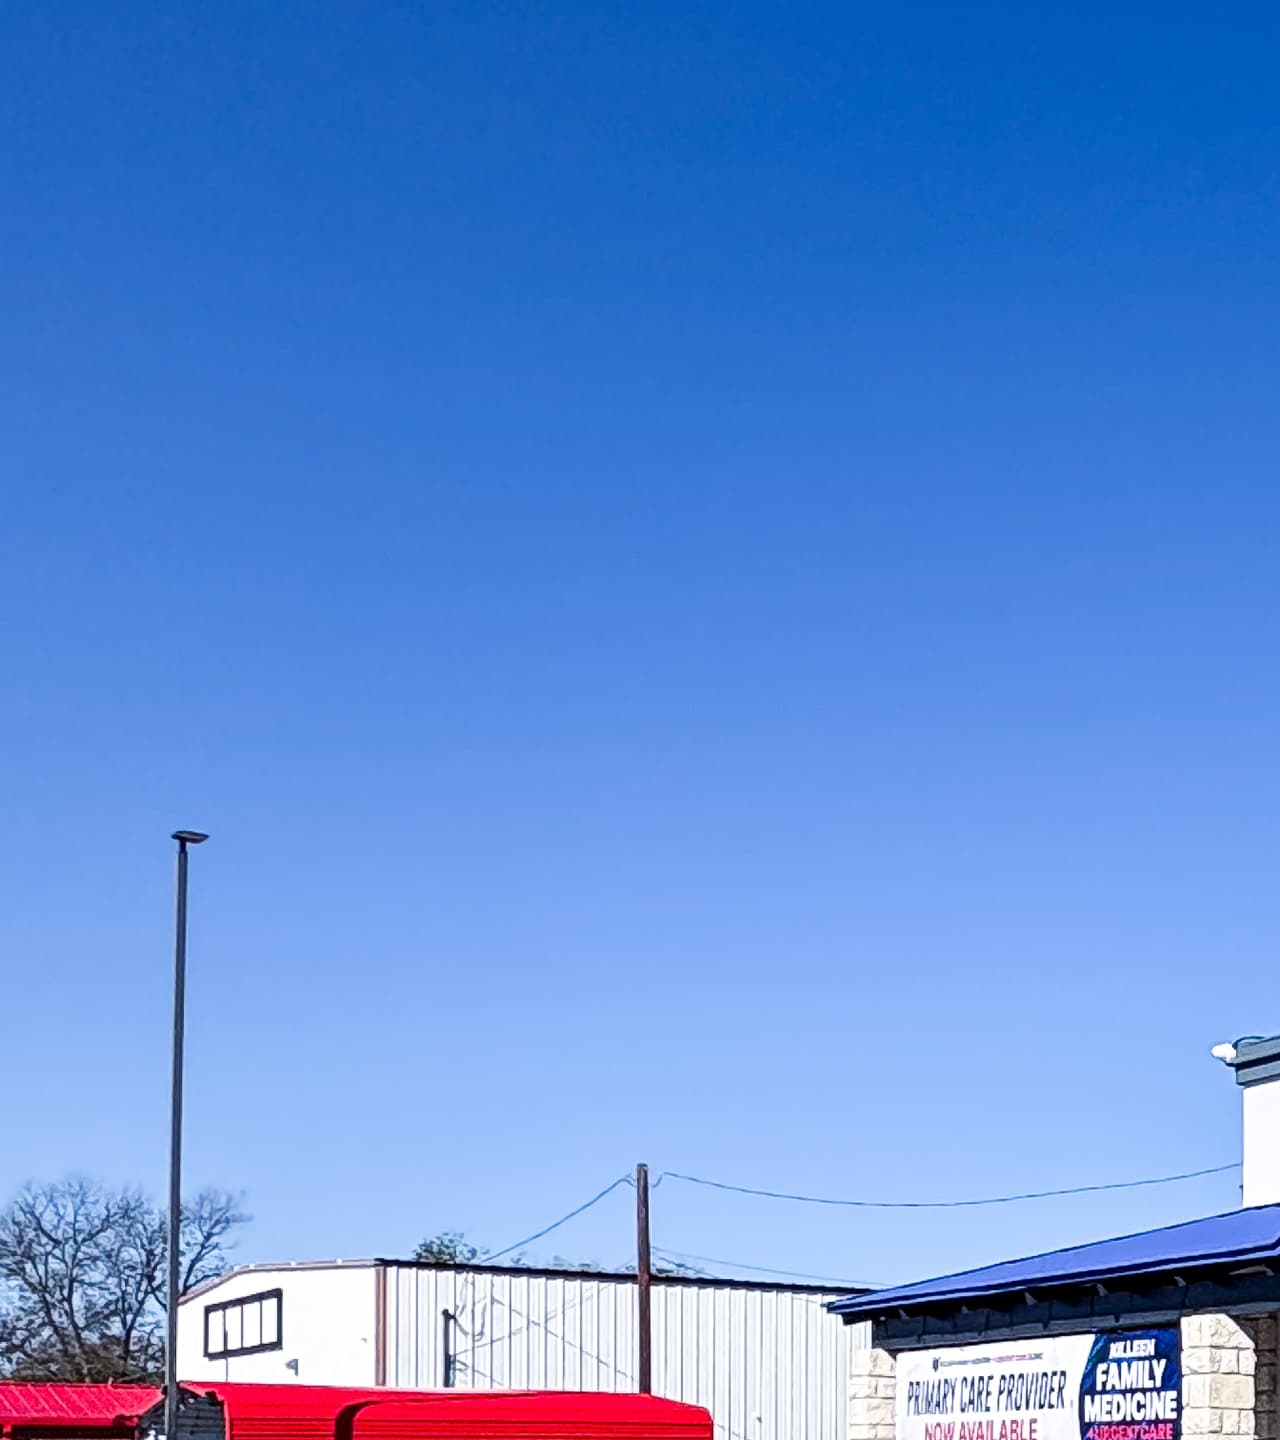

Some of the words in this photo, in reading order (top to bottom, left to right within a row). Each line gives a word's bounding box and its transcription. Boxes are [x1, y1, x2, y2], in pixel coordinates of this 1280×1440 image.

[1109, 1339, 1156, 1359] KILLEEN
[1096, 1359, 1167, 1391] FAMILY
[907, 1377, 957, 1416] PRIMARY
[960, 1374, 994, 1413] CARE
[997, 1370, 1066, 1412] PROVIDER
[1084, 1390, 1178, 1422] MEDICINE
[1140, 1423, 1173, 1440] CARE
